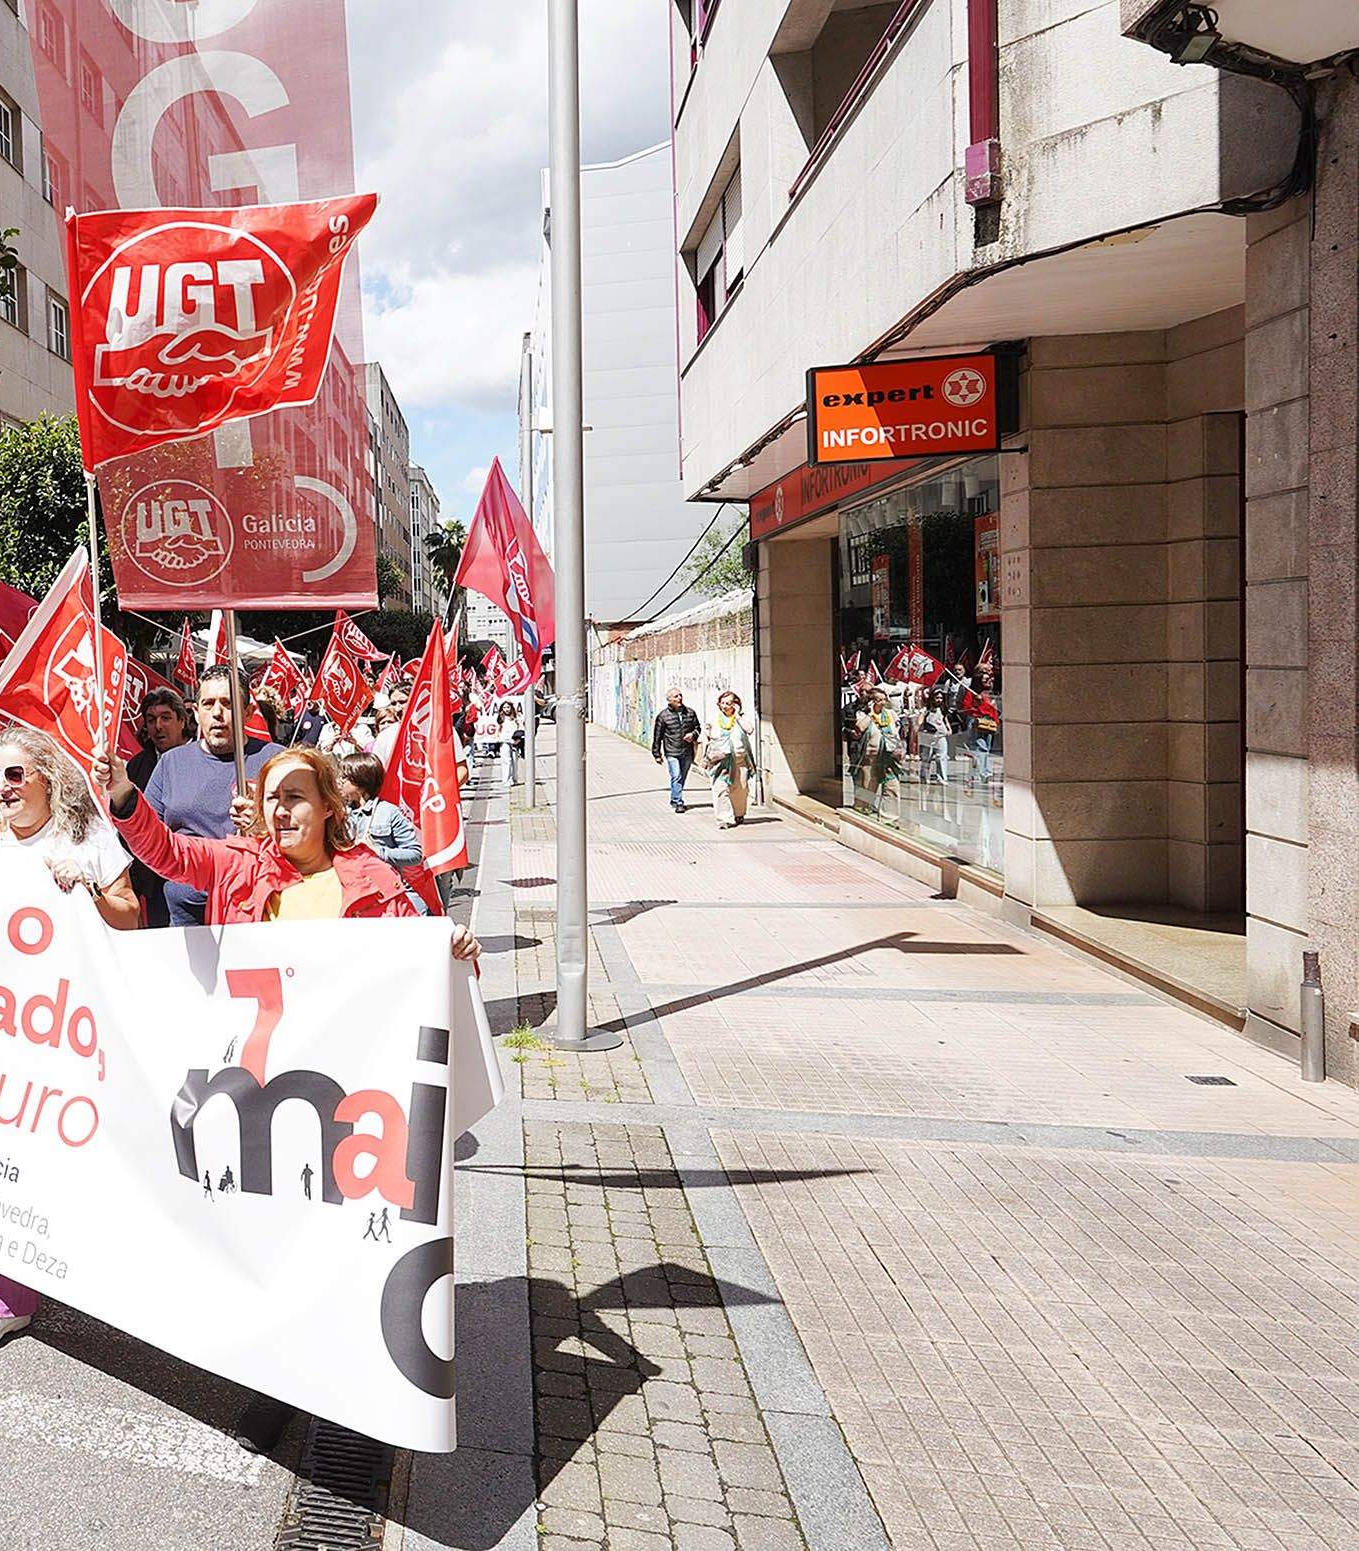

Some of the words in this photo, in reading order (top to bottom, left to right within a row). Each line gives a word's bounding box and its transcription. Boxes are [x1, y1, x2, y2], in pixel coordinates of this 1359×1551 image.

[105, 259, 265, 346] UGT
[823, 384, 935, 408] expert
[823, 418, 988, 448] INFORTRONIC
[136, 499, 216, 541] UGT
[242, 514, 316, 534] Galicia
[244, 539, 316, 550] PONTEVEDRA
[476, 723, 497, 735] UG
[7, 906, 54, 955] o
[8, 1240, 19, 1258] e
[22, 1240, 69, 1280] Deza
